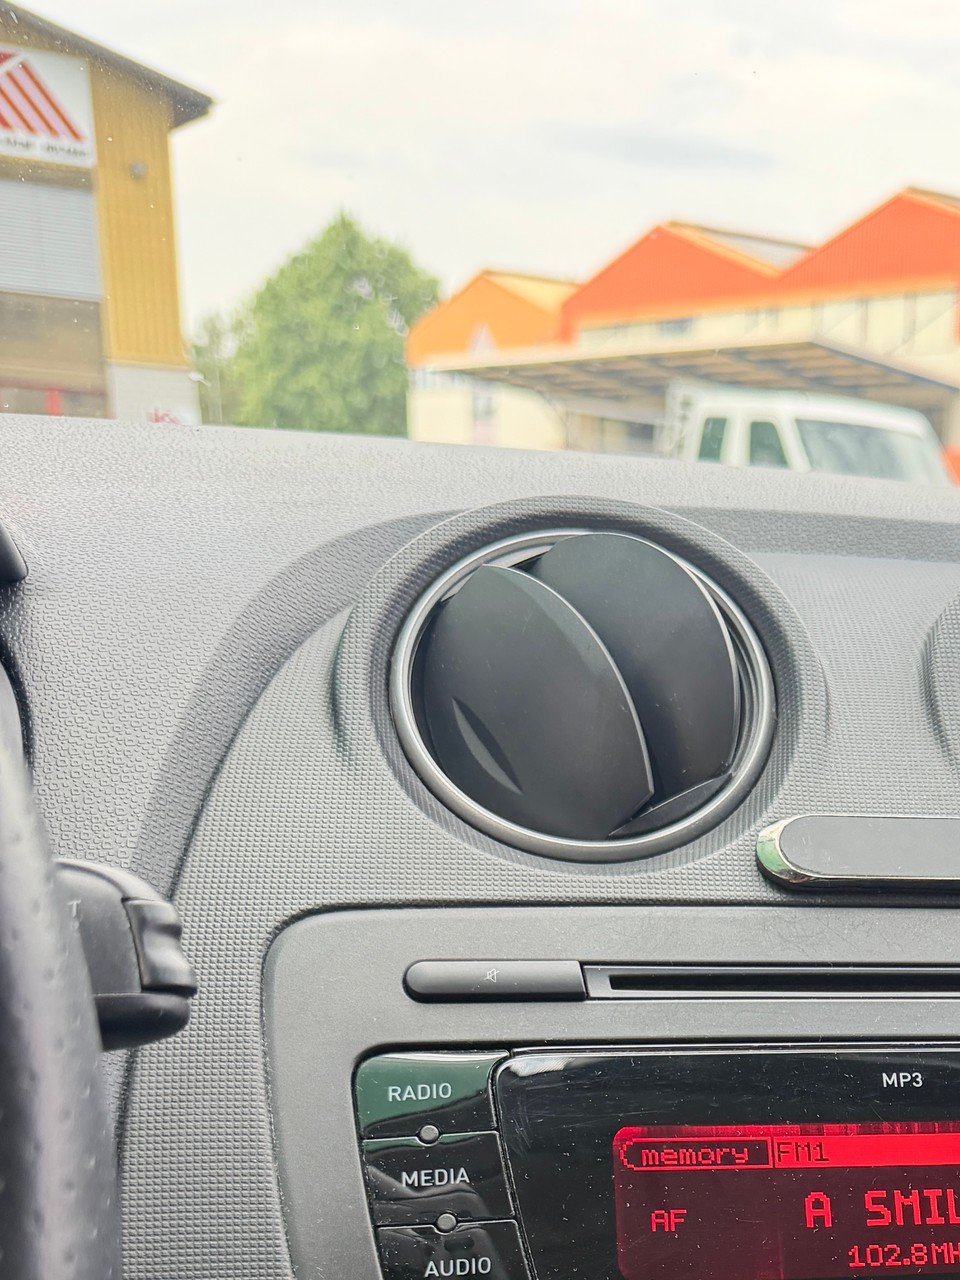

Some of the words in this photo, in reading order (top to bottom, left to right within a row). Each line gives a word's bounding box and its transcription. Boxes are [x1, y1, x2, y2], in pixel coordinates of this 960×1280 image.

[882, 1072, 923, 1088] MP3
[387, 1082, 452, 1102] RADIO
[641, 1147, 749, 1167] memory
[776, 1141, 829, 1163] FM1
[401, 1167, 470, 1188] MEDIA
[804, 1191, 833, 1228] A
[651, 1209, 687, 1232] AF
[424, 1257, 492, 1278] AUDIO
